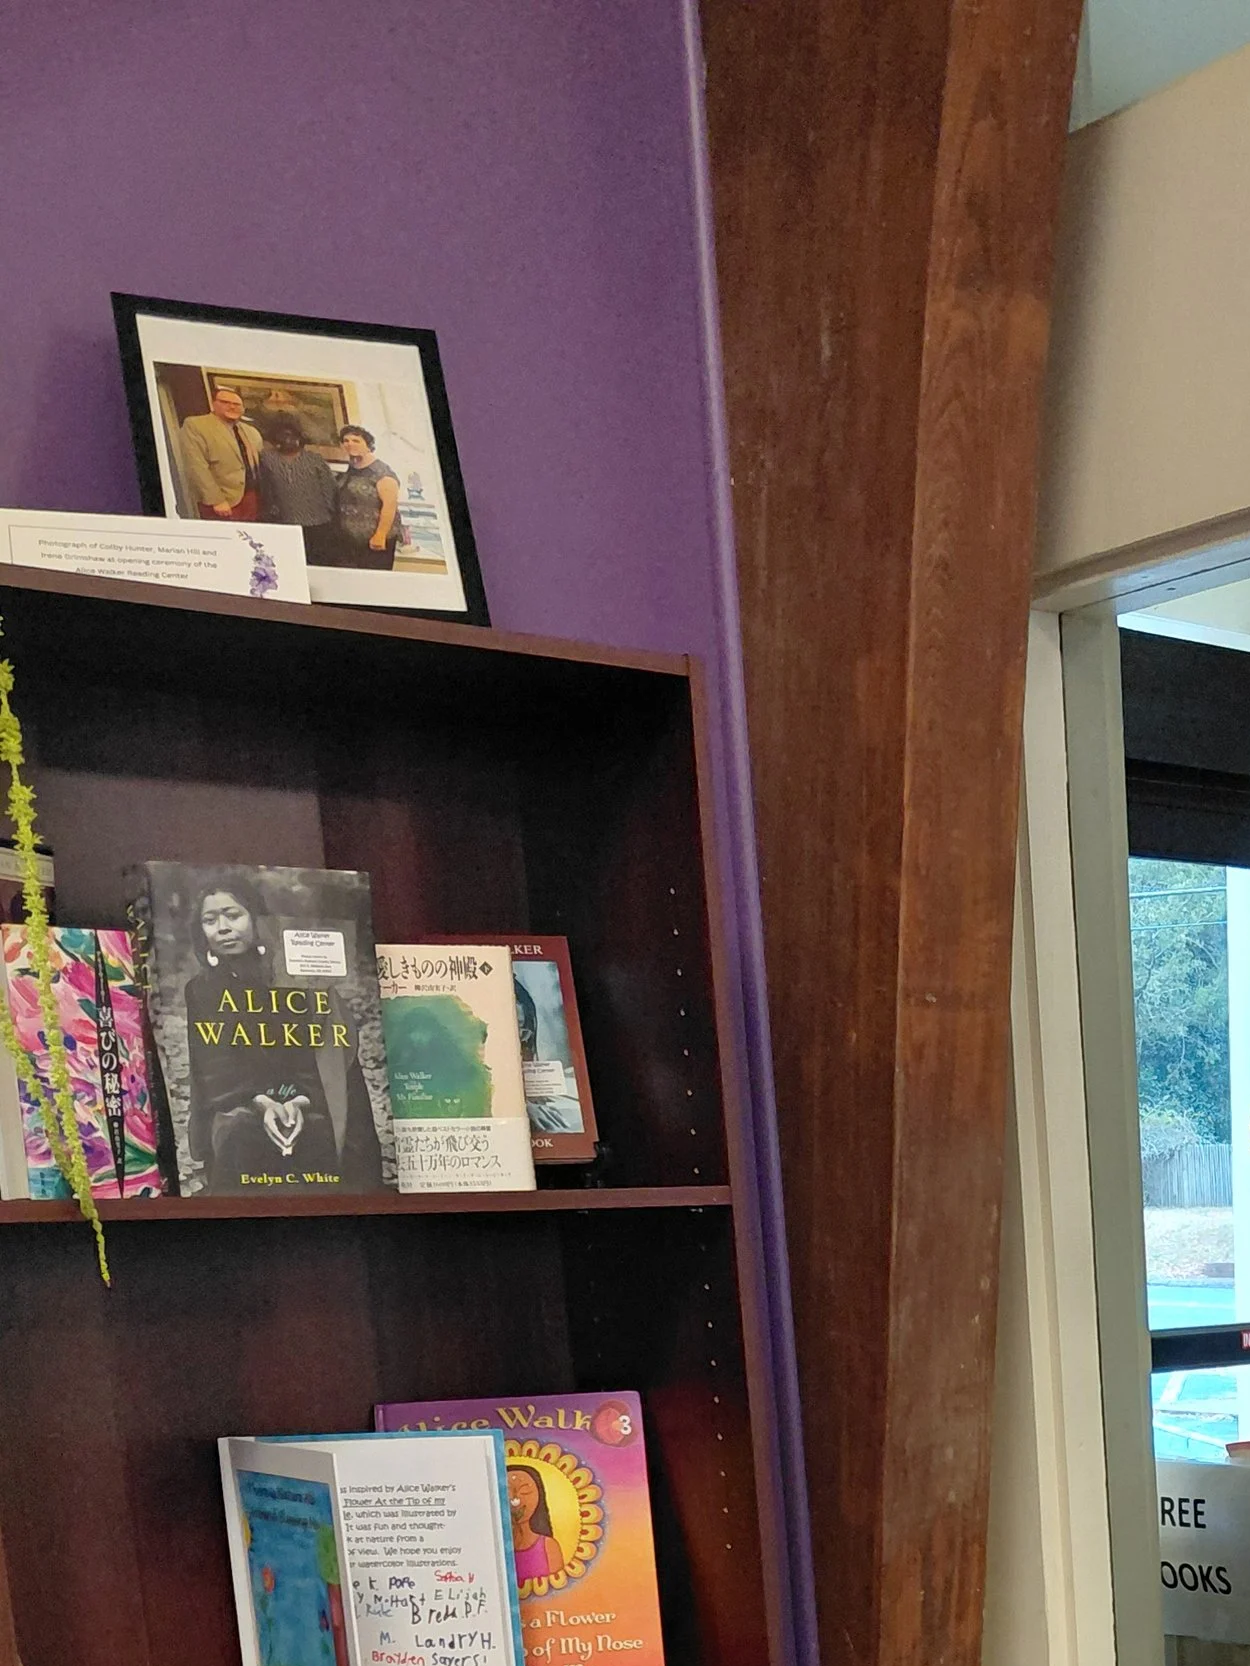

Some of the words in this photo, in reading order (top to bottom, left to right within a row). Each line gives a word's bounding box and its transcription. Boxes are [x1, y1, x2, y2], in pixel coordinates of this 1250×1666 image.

[217, 989, 332, 1016] ALICE
[194, 1021, 350, 1048] WALKER
[278, 1083, 297, 1097] life
[240, 1172, 283, 1187] Evelyn
[285, 1173, 299, 1185] C.
[302, 1173, 340, 1184] White
[1243, 1332, 1250, 1347] IN
[496, 1404, 593, 1433] Walk
[385, 1484, 394, 1494] by
[396, 1483, 419, 1493] Alice
[389, 1497, 404, 1506] the
[406, 1496, 421, 1507] Tip
[422, 1496, 432, 1506] of
[1161, 1497, 1206, 1528] REE
[1161, 1561, 1232, 1595] OOKS
[531, 1616, 542, 1628] a
[545, 1610, 617, 1629] Flower
[533, 1638, 556, 1664] of
[560, 1635, 593, 1660] My
[597, 1635, 644, 1652] Nose
